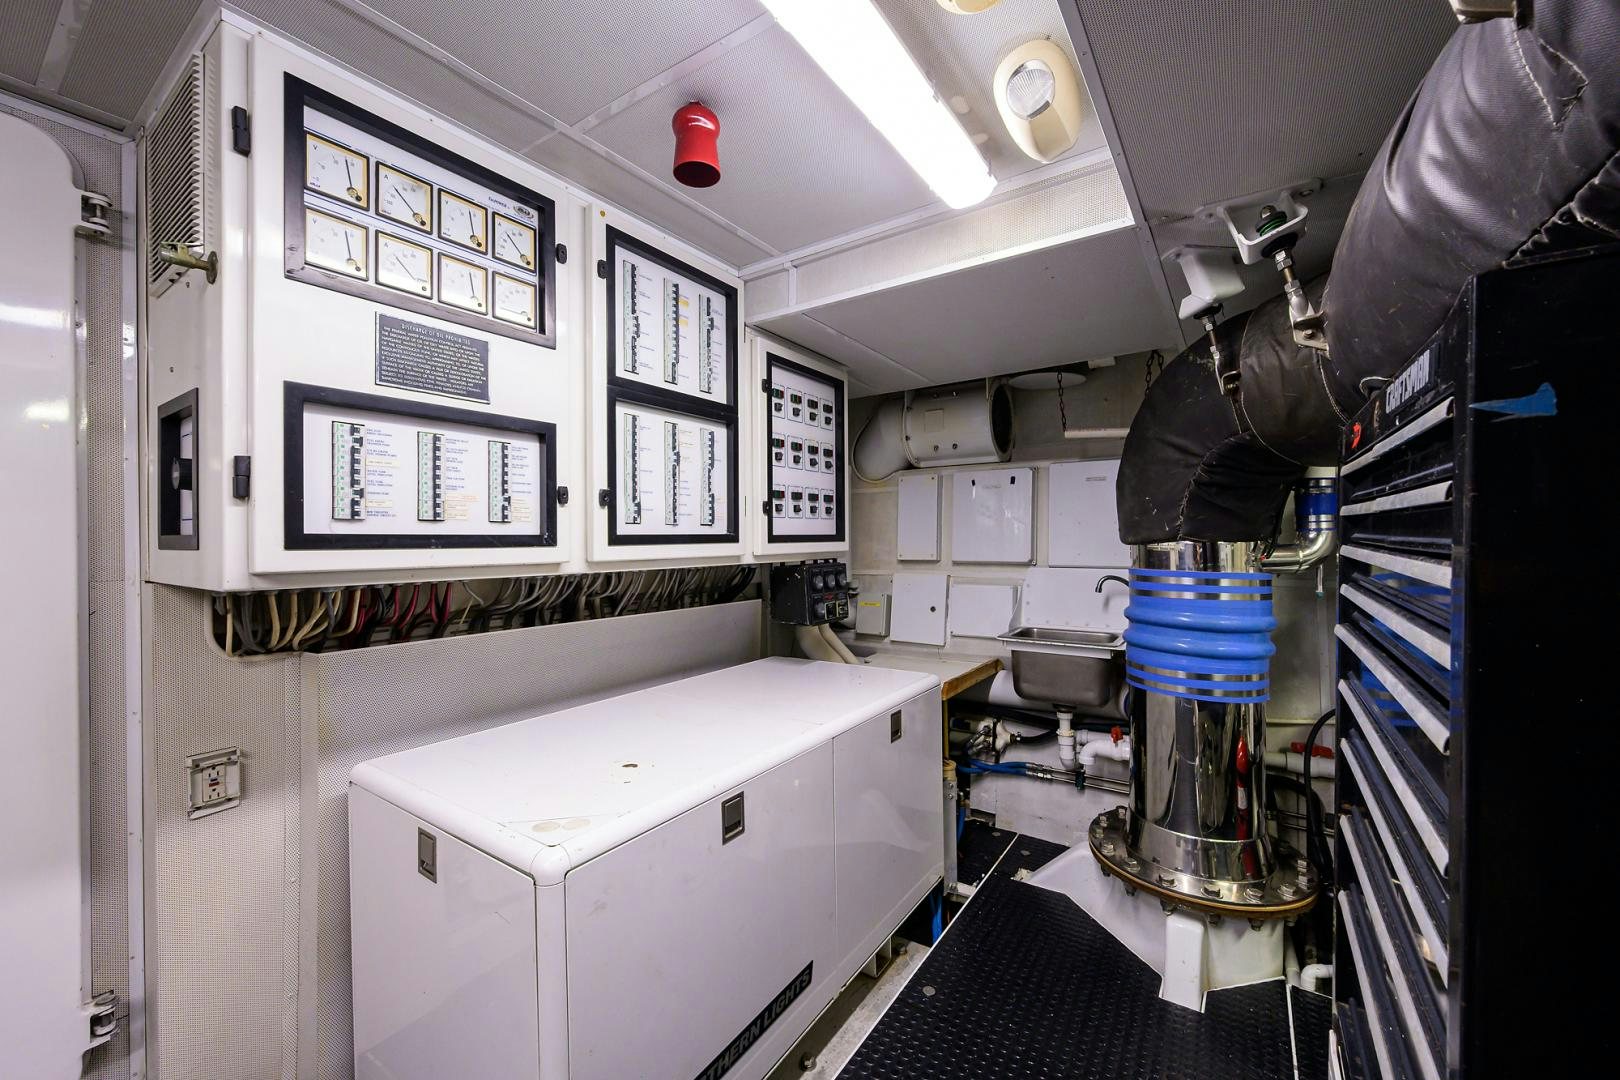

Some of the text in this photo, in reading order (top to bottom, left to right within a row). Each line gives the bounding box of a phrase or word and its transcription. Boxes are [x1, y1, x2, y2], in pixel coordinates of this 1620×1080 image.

[1385, 349, 1430, 414] CRAFTSMAN
[700, 969, 811, 1080] THERN LIGHTS
